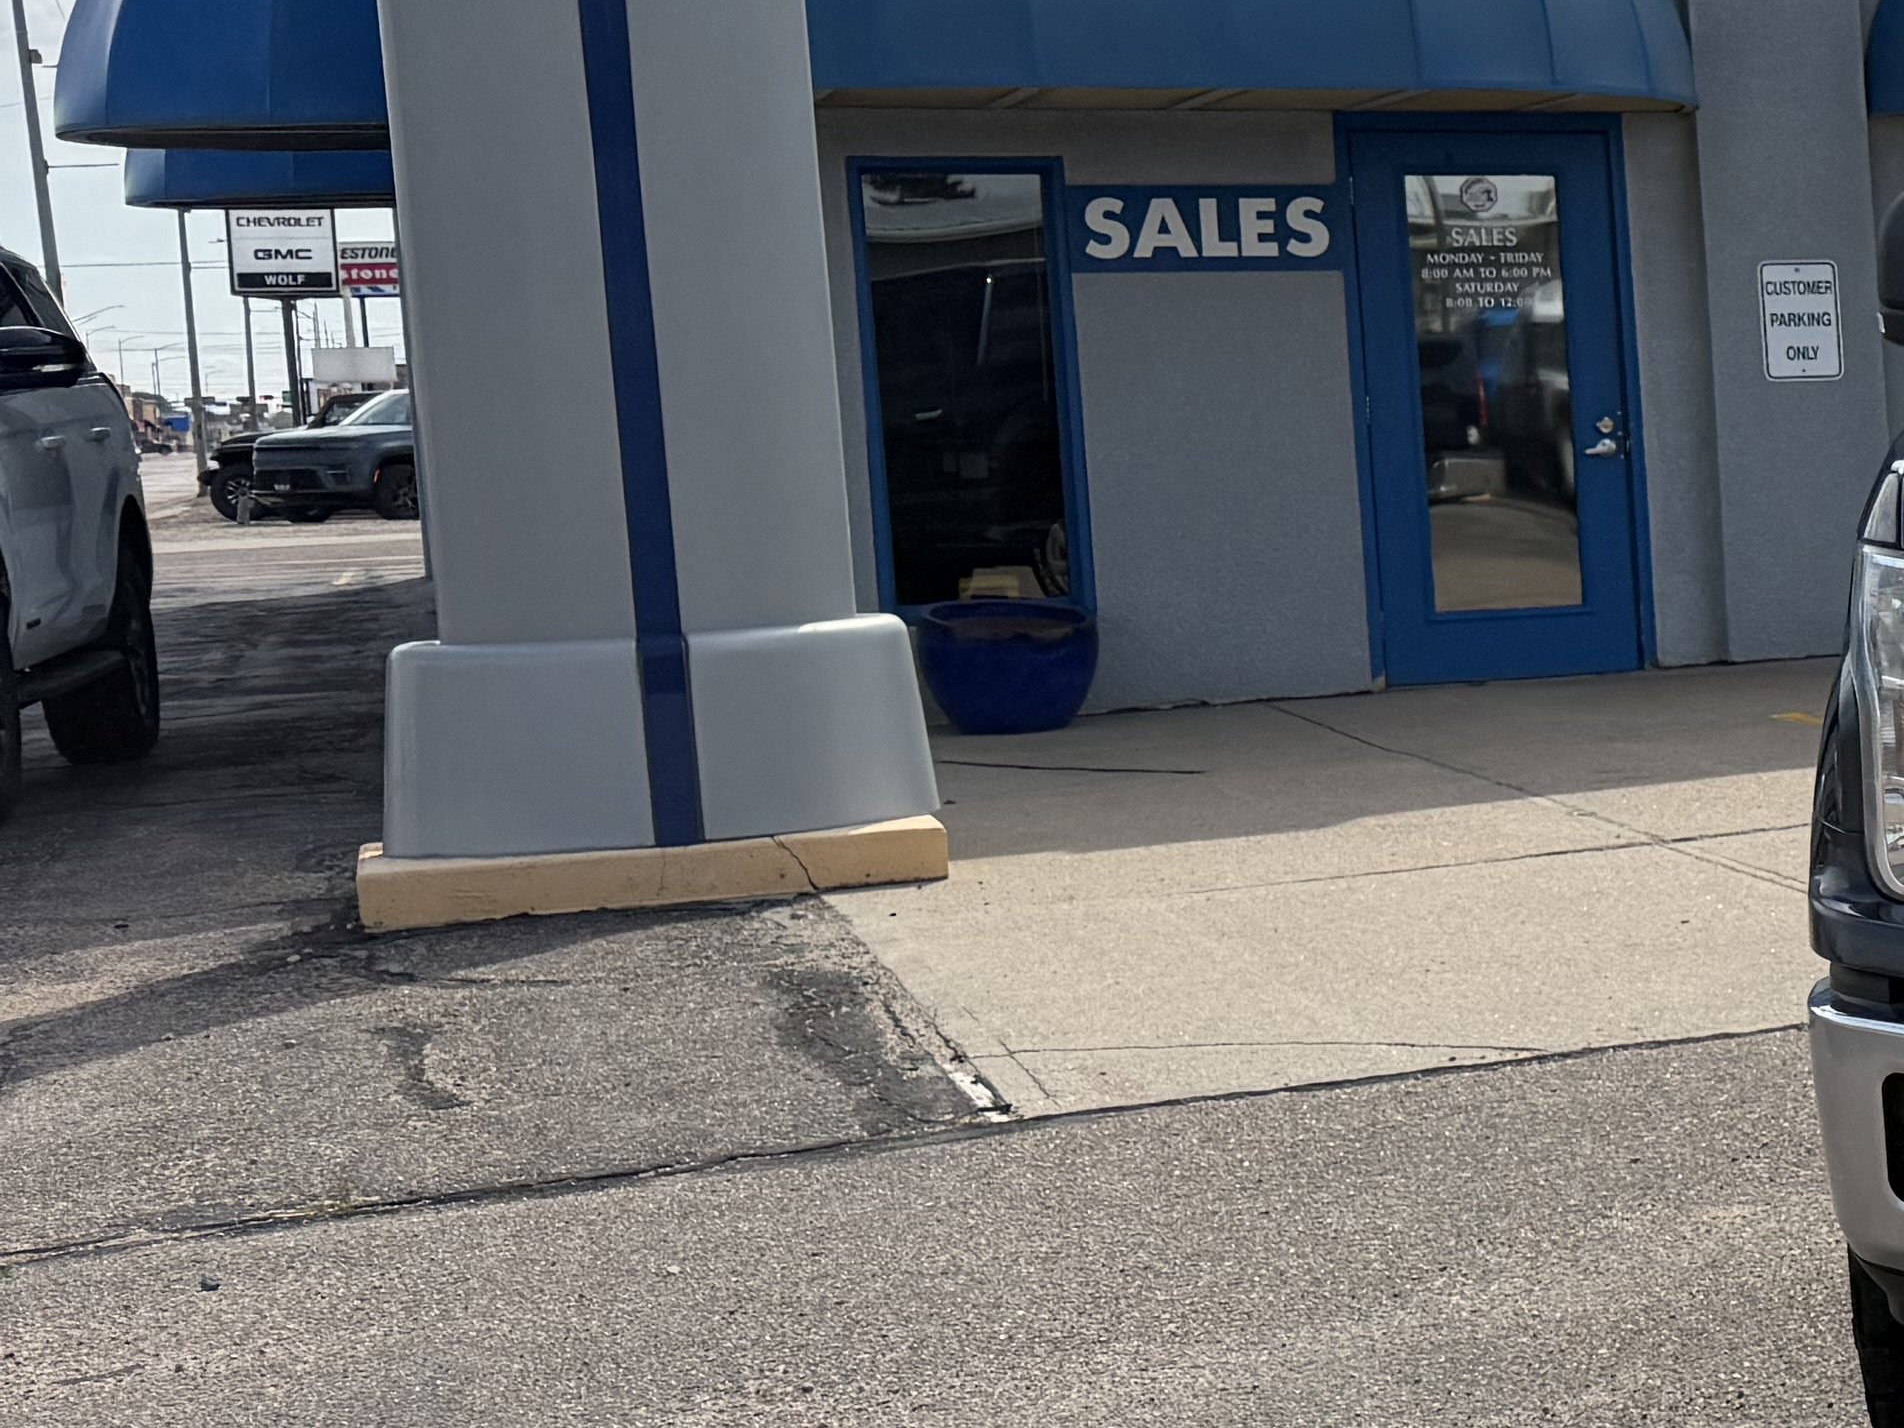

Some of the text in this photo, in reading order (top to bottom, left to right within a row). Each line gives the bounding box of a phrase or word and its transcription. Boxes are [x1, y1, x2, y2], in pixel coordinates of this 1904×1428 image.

[236, 216, 325, 228] CHEVROLET
[1084, 196, 1330, 260] SALES
[1451, 227, 1518, 247] SALES
[253, 248, 313, 260] GMC
[1426, 252, 1485, 264] MONDAY
[1500, 252, 1544, 264] FRIDAY
[1421, 267, 1552, 279] 8:00 AM TO 6:00 PM
[264, 274, 306, 286] WOLF
[1455, 282, 1520, 293] SATURDAY
[1765, 280, 1832, 295] CUSTOMER
[1478, 297, 1495, 308] TO
[1769, 312, 1832, 327] PARKING
[1786, 345, 1820, 361] ONLY
